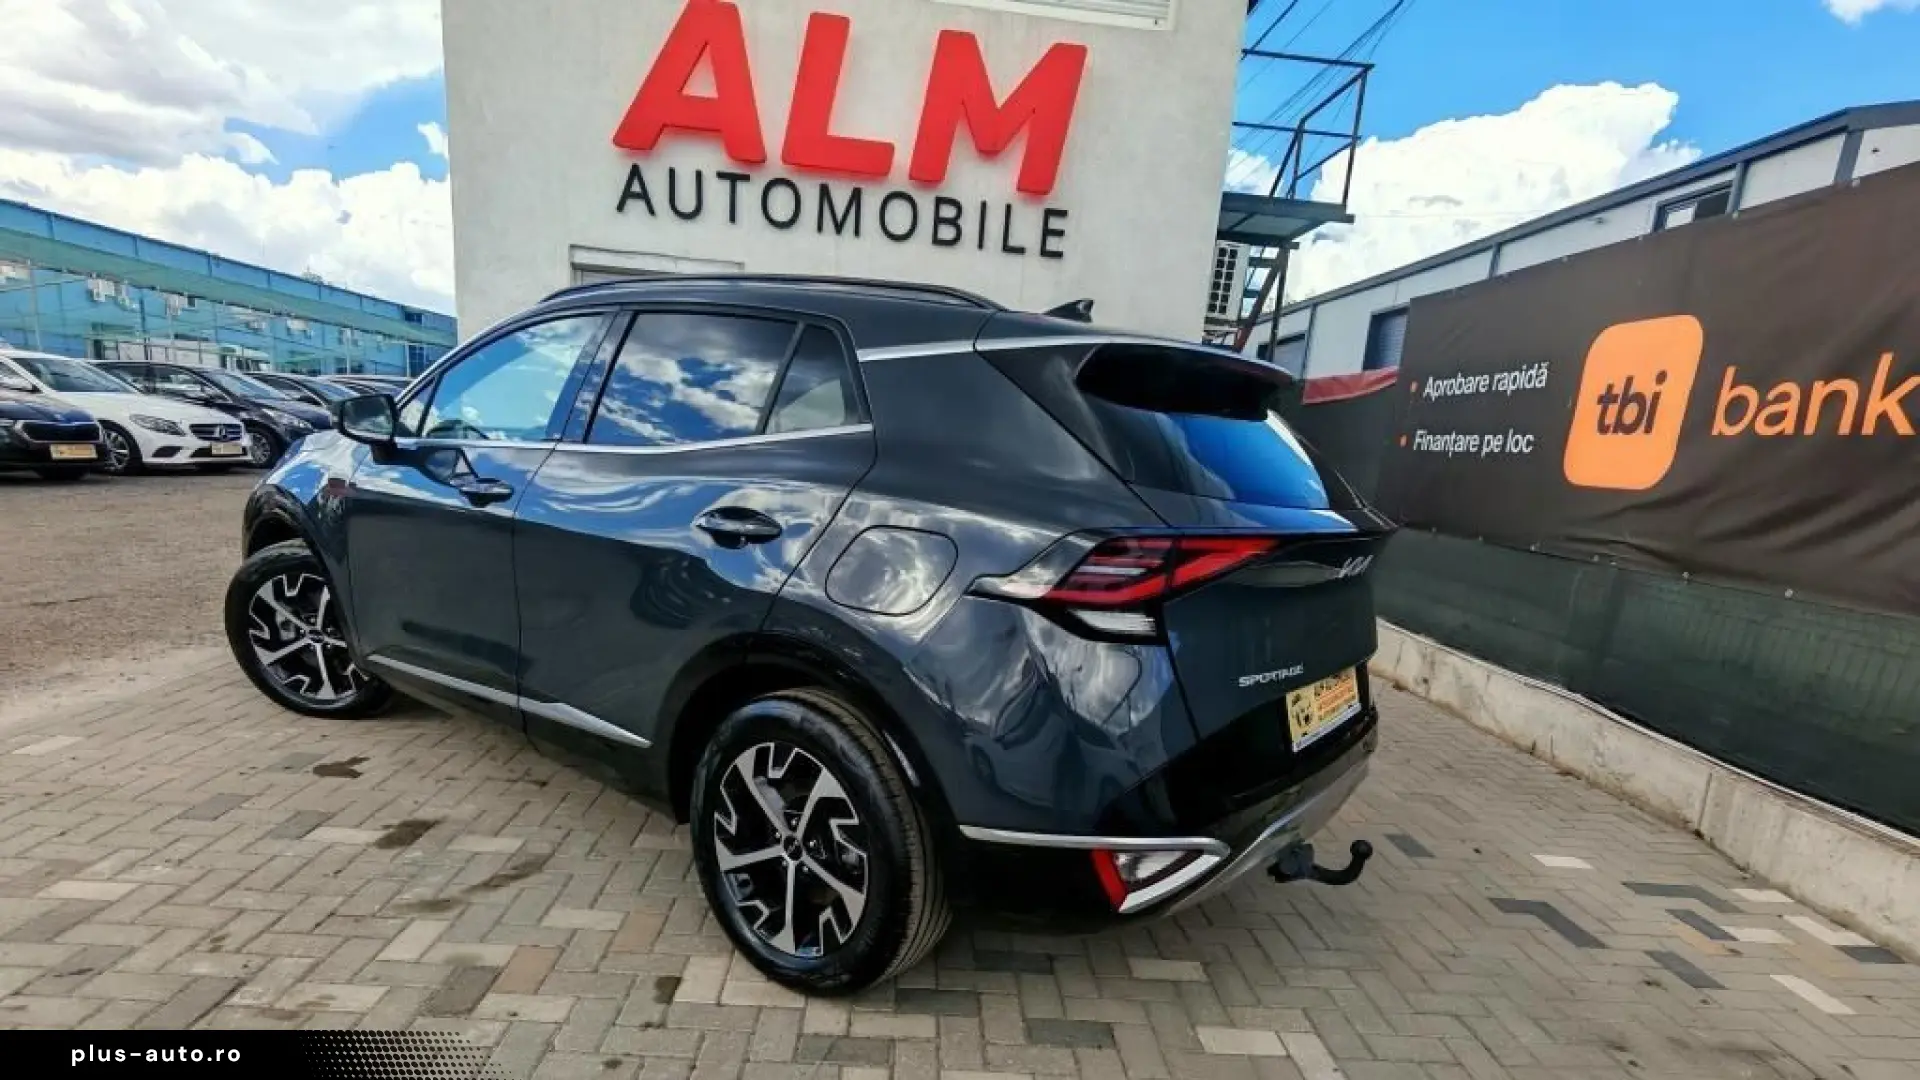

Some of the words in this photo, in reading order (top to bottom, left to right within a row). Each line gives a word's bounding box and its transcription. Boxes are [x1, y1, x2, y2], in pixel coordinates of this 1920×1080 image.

[612, 0, 1088, 196] ALM
[616, 162, 1069, 259] AUTOMOBILE
[1422, 372, 1490, 402] Aprobare
[1492, 362, 1549, 396] rapidă
[1595, 370, 1669, 436] tbi
[1711, 352, 1920, 437] bank
[1481, 433, 1505, 458] pe
[1505, 428, 1535, 453] loc
[1238, 662, 1304, 687] SPORTAGE
